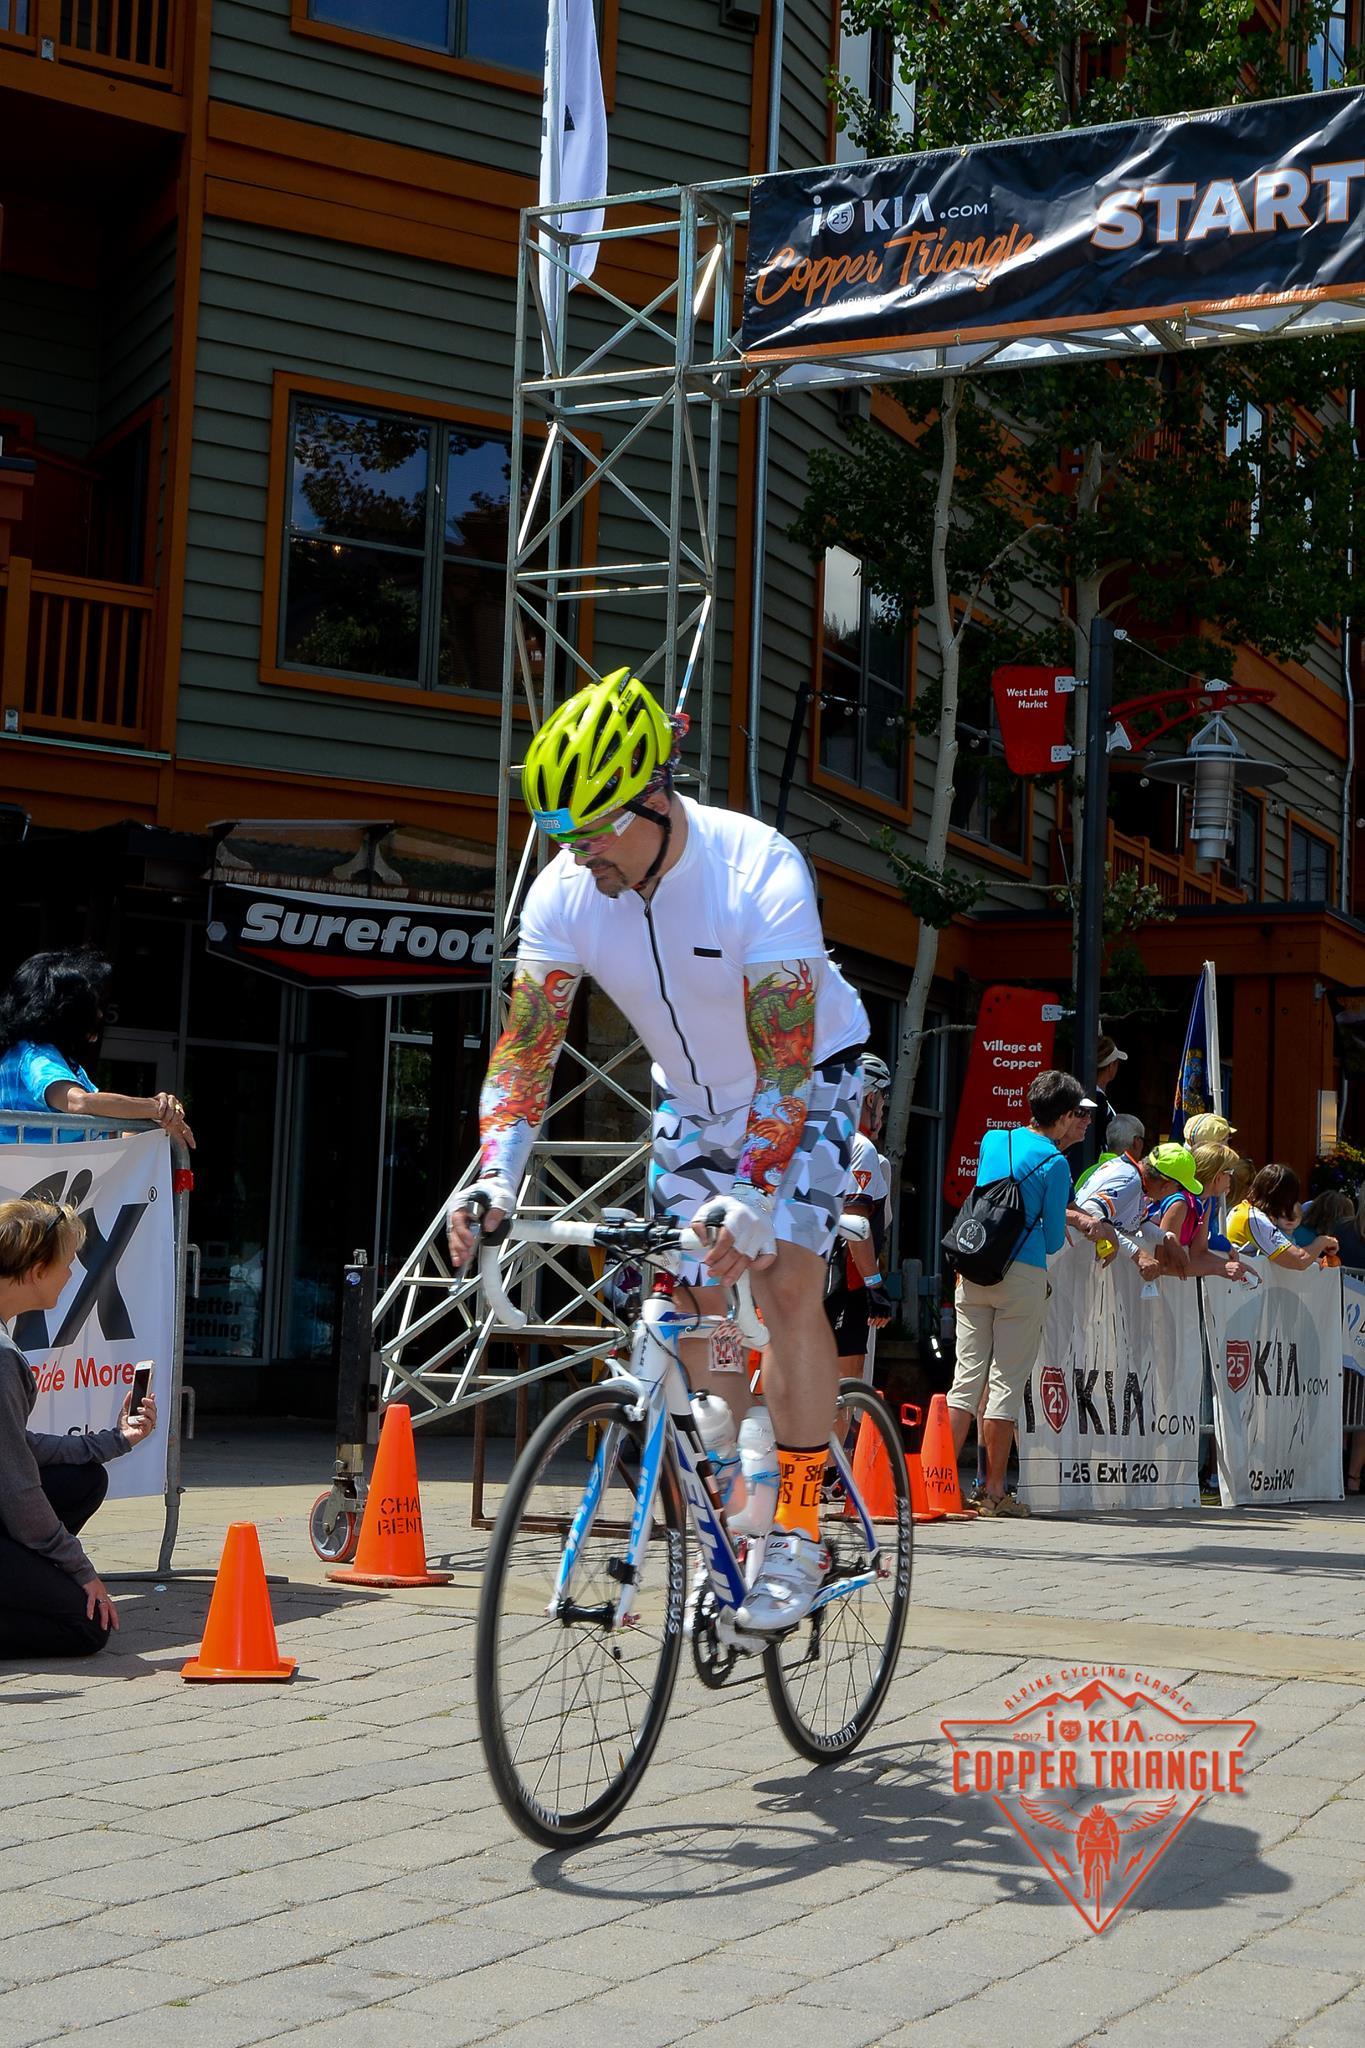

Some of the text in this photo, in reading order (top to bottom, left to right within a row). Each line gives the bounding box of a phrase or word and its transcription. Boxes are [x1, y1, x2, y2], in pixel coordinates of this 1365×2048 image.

[1090, 159, 1365, 250] START
[755, 223, 1041, 307] Copper Triangle
[1006, 688, 1049, 697] West Lake
[1018, 700, 1048, 709] Market
[240, 902, 495, 964] Surefoot
[982, 1040, 1043, 1053] Village at
[992, 1057, 1042, 1069] Copper
[992, 1086, 1024, 1098] Chapel
[1007, 1097, 1023, 1107] Lot
[986, 1118, 1022, 1129] Express
[74, 1357, 135, 1389] More
[1227, 1356, 1246, 1378] 25
[1059, 1462, 1159, 1484] I-25 Exit 240
[668, 1529, 683, 1634] AMADEUS
